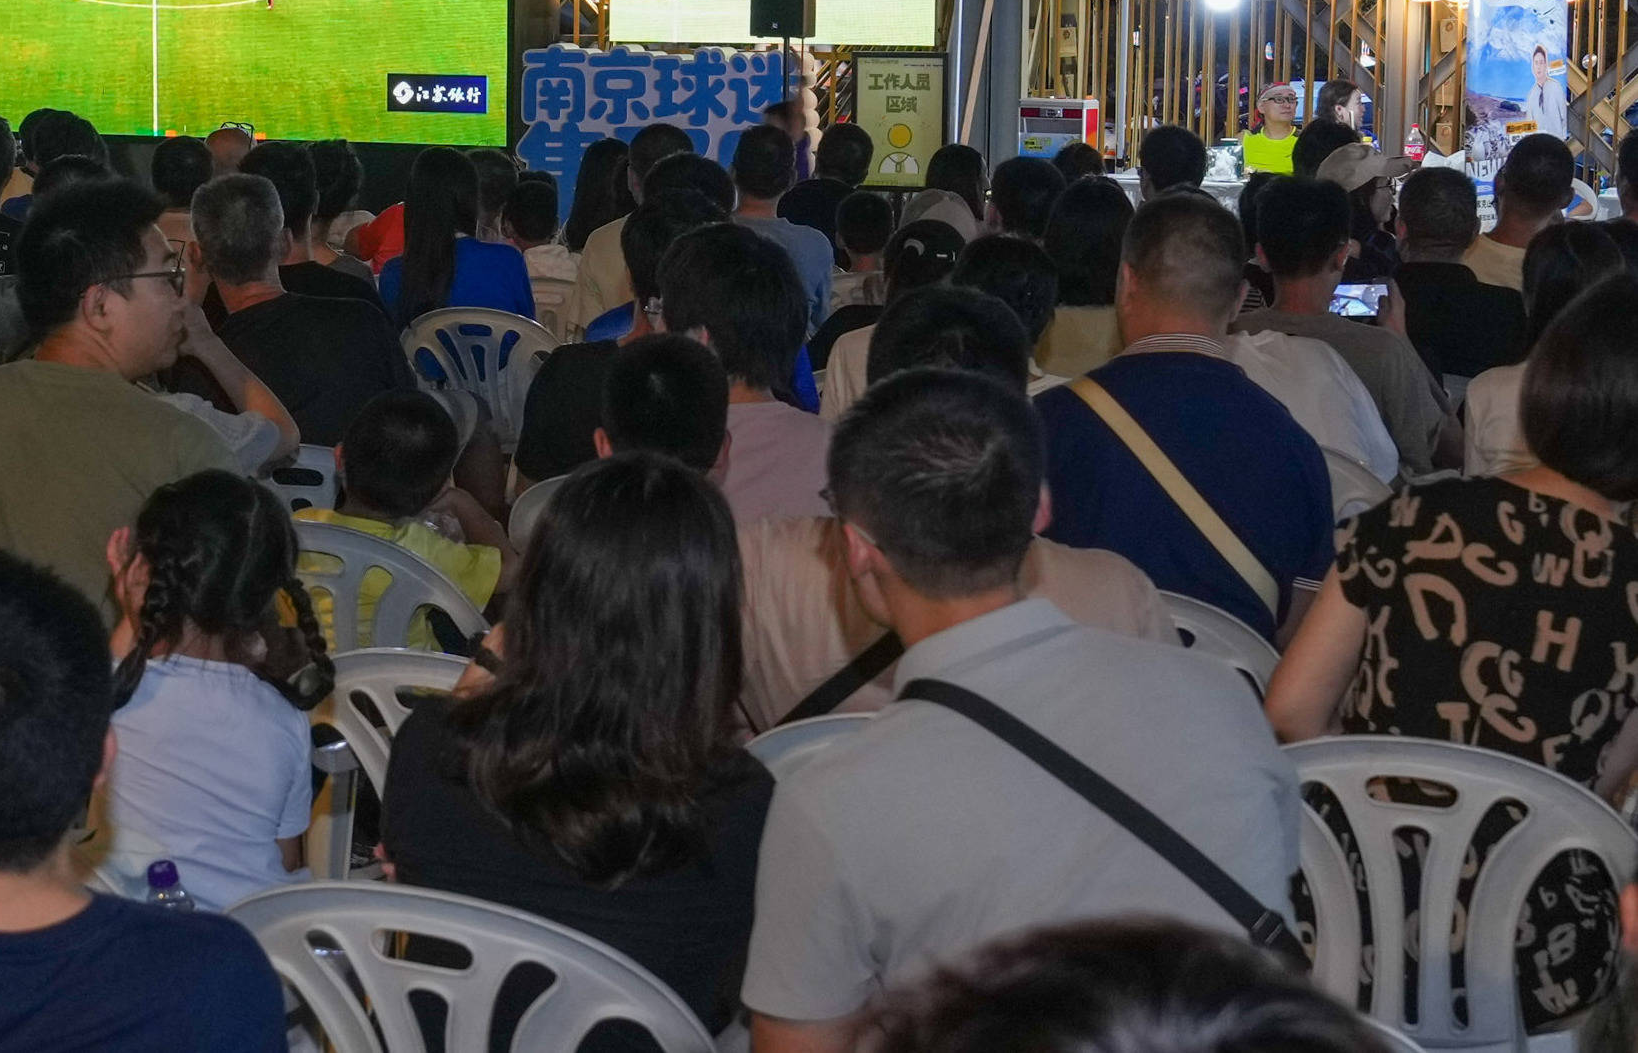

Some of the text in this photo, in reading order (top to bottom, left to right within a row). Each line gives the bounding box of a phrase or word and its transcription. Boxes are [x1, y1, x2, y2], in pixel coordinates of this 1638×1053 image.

[523, 46, 800, 125] 南京球迷
[868, 73, 930, 90] 工作人员
[886, 96, 917, 113] 区域
